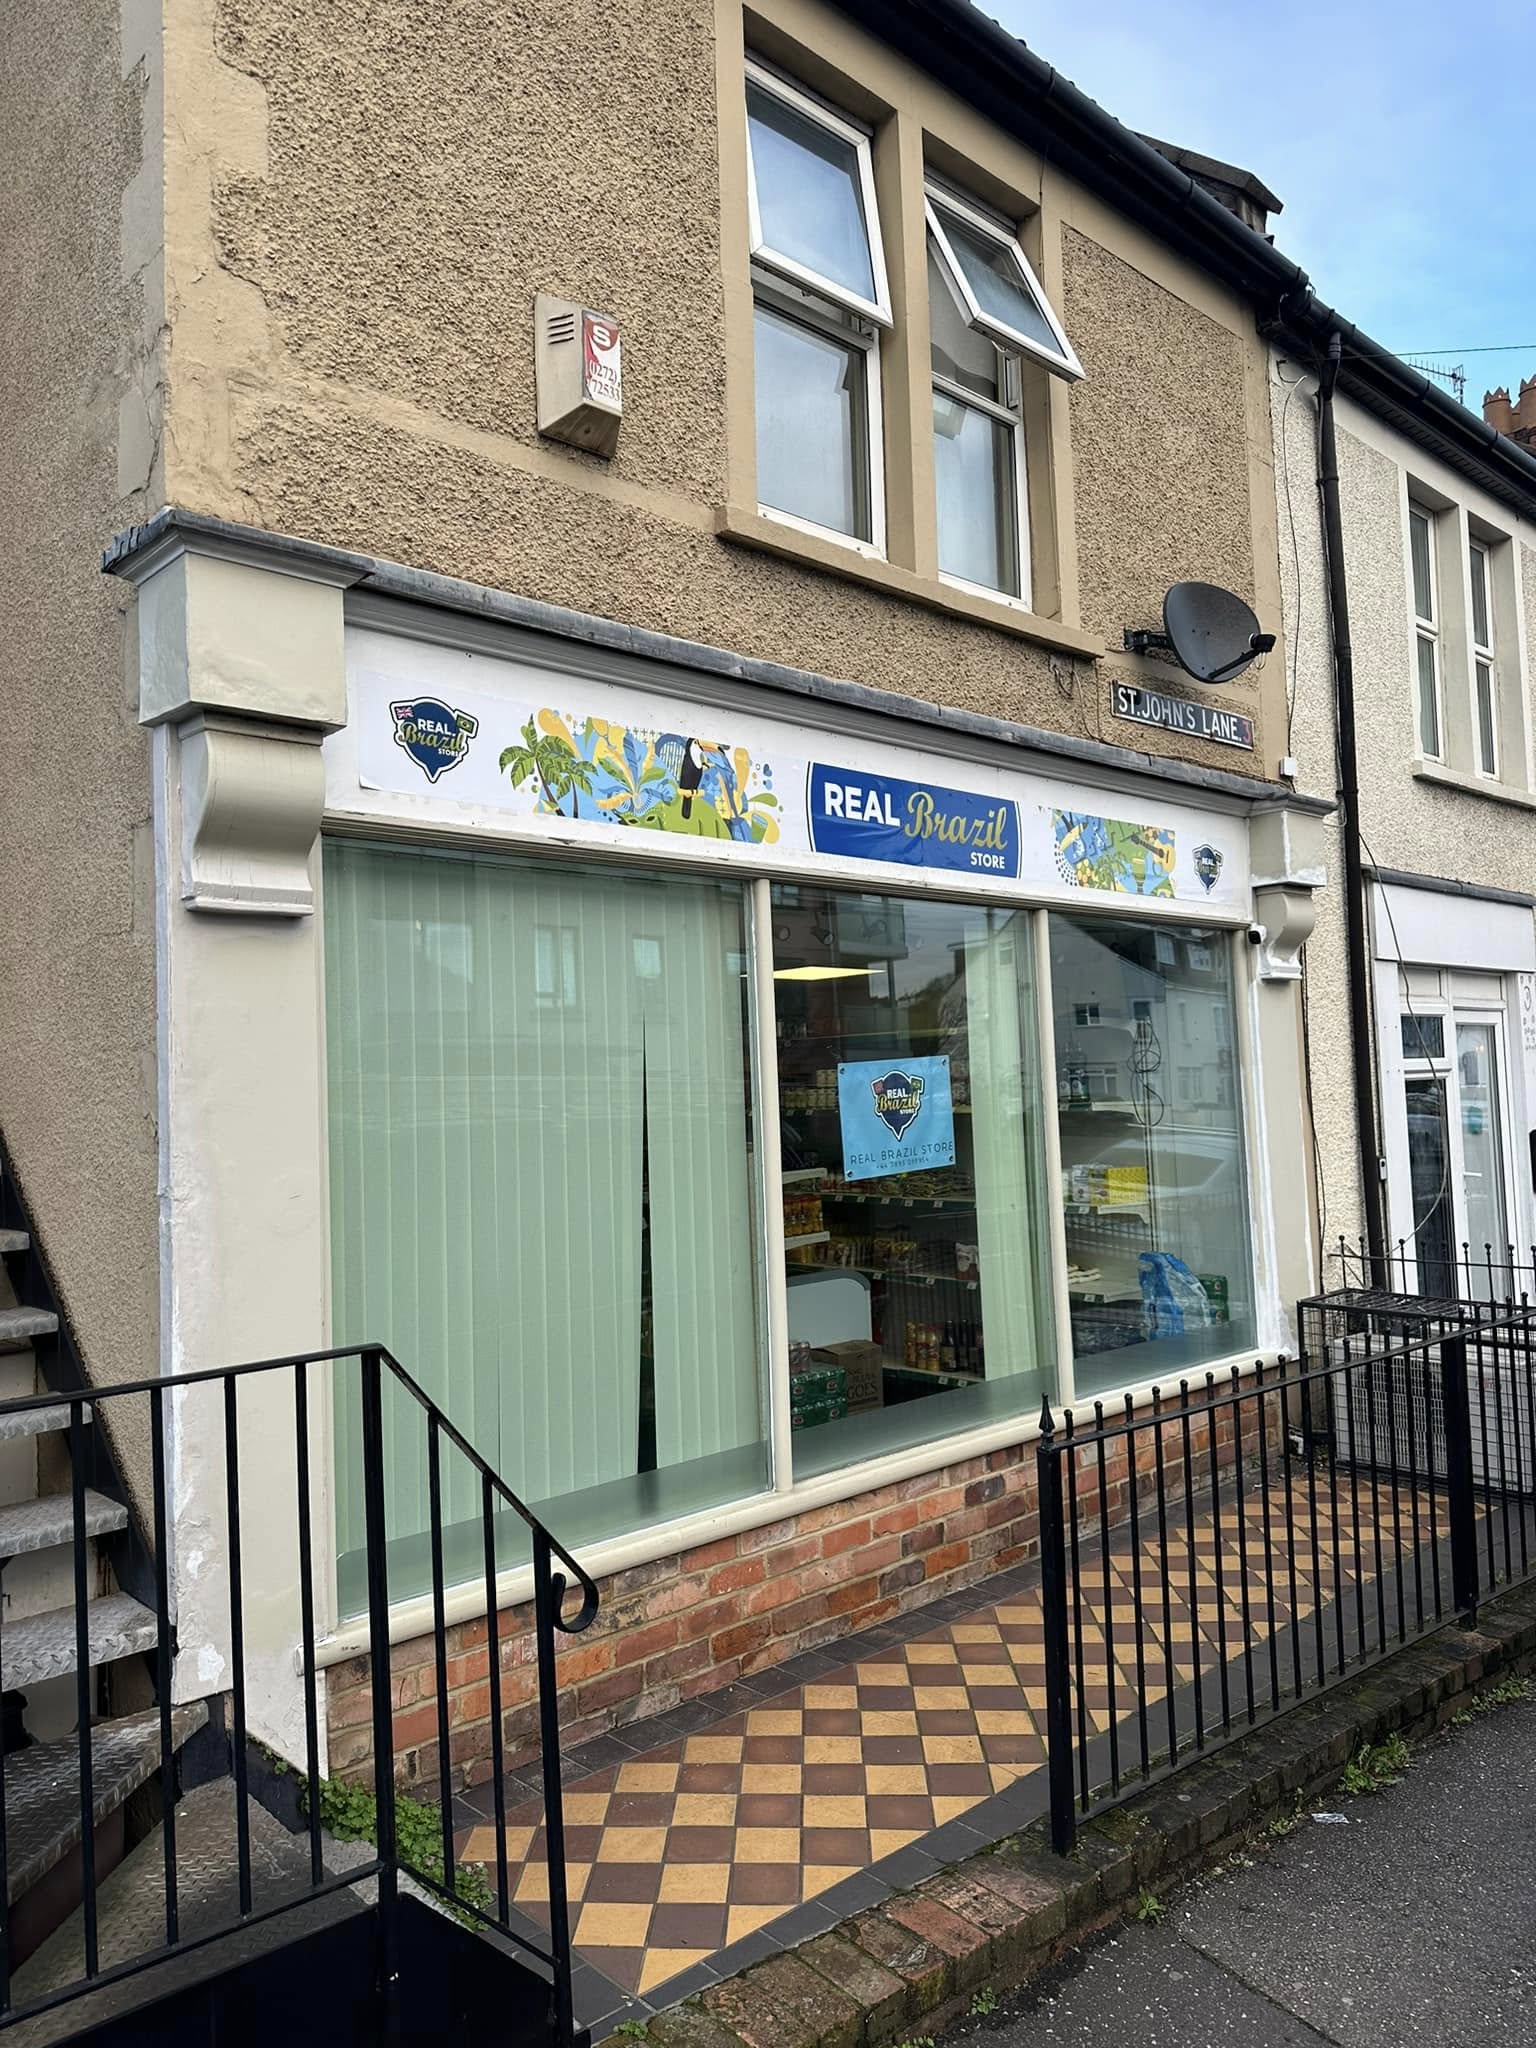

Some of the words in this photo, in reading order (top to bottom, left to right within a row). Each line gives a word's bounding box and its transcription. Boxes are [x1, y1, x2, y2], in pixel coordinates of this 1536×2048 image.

[397, 721, 465, 752] Brazil
[417, 718, 452, 736] REAL
[824, 782, 900, 827] REAL
[904, 791, 1008, 851] Brazil
[970, 851, 1006, 870] STORE
[877, 1091, 919, 1112] Brazil
[886, 1087, 907, 1099] REAL
[850, 1152, 876, 1166] REAL
[881, 1146, 918, 1160] BRAZIL
[921, 1141, 953, 1155] STORE
